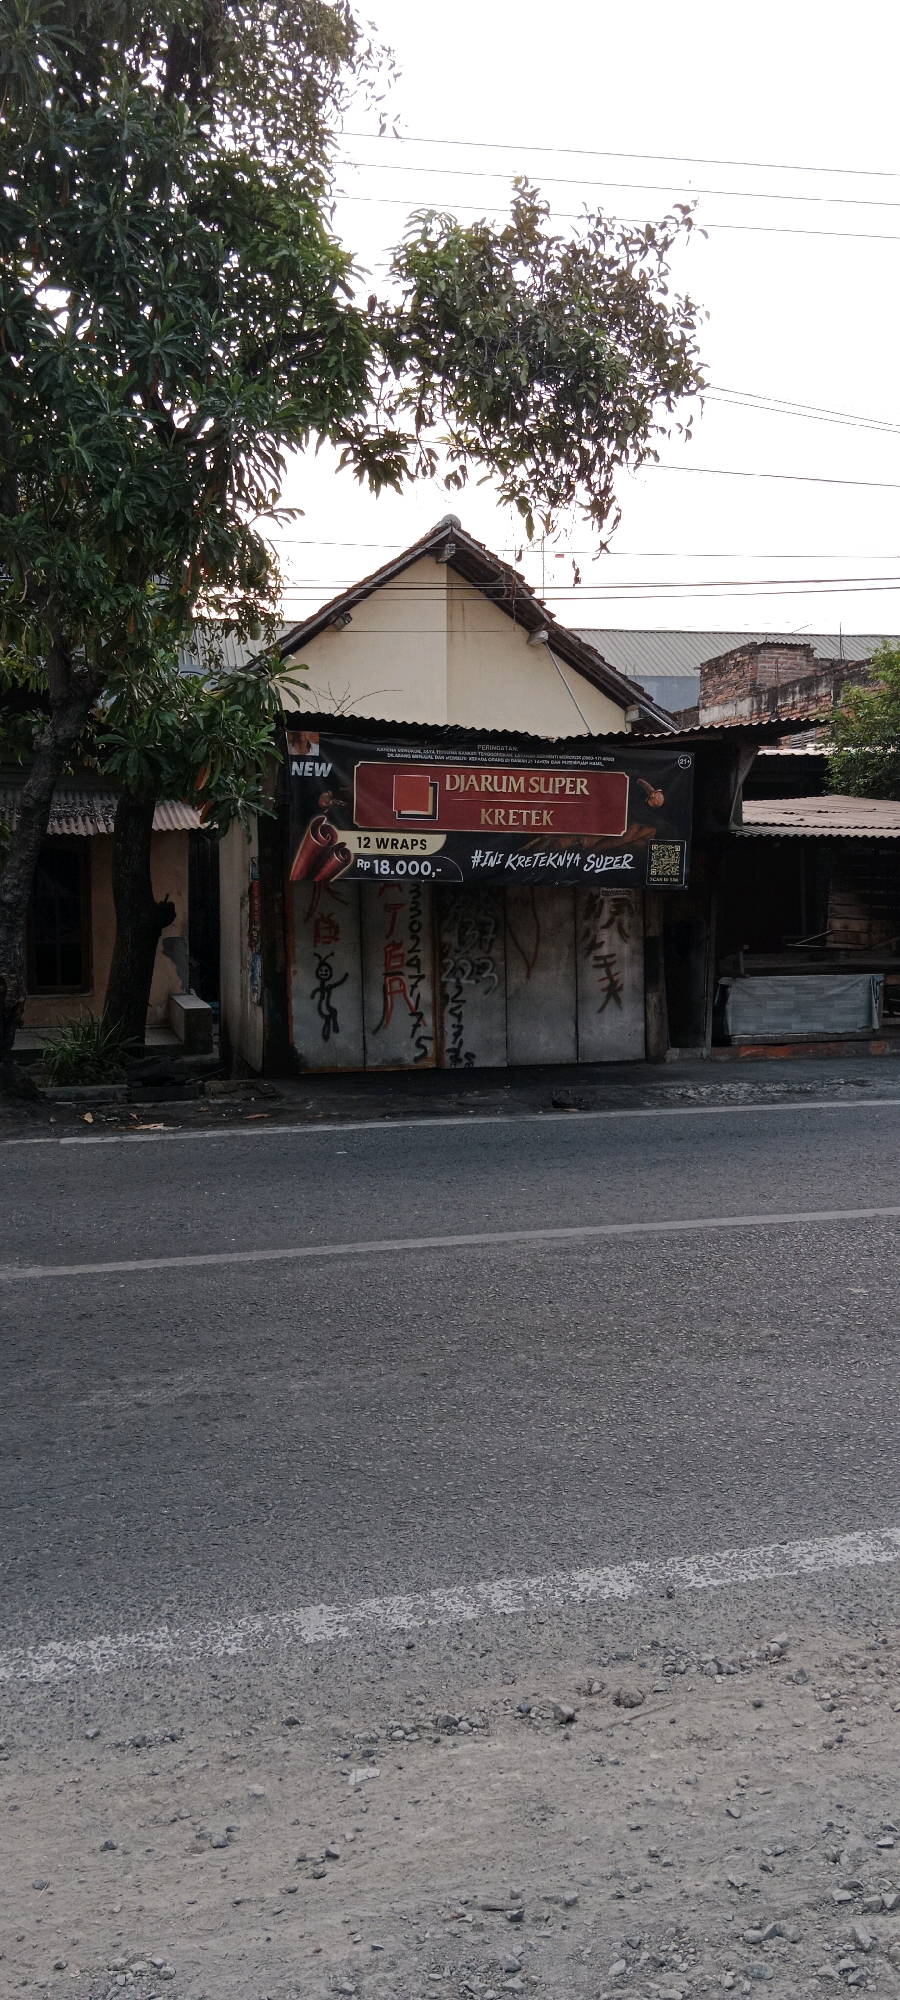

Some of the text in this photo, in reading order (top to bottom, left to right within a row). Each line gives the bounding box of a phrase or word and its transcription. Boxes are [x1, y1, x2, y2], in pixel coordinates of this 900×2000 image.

[477, 744, 519, 752] PERINGATAN:
[291, 761, 333, 777] NEW
[680, 757, 690, 765] 21+
[445, 774, 589, 796] DJARUM SUPER
[479, 808, 555, 826] KRETEK
[356, 836, 427, 851] 12 WRAPS
[356, 859, 442, 878] Rp 18.000,-
[471, 849, 505, 869] #INI
[582, 853, 636, 874] SUPER
